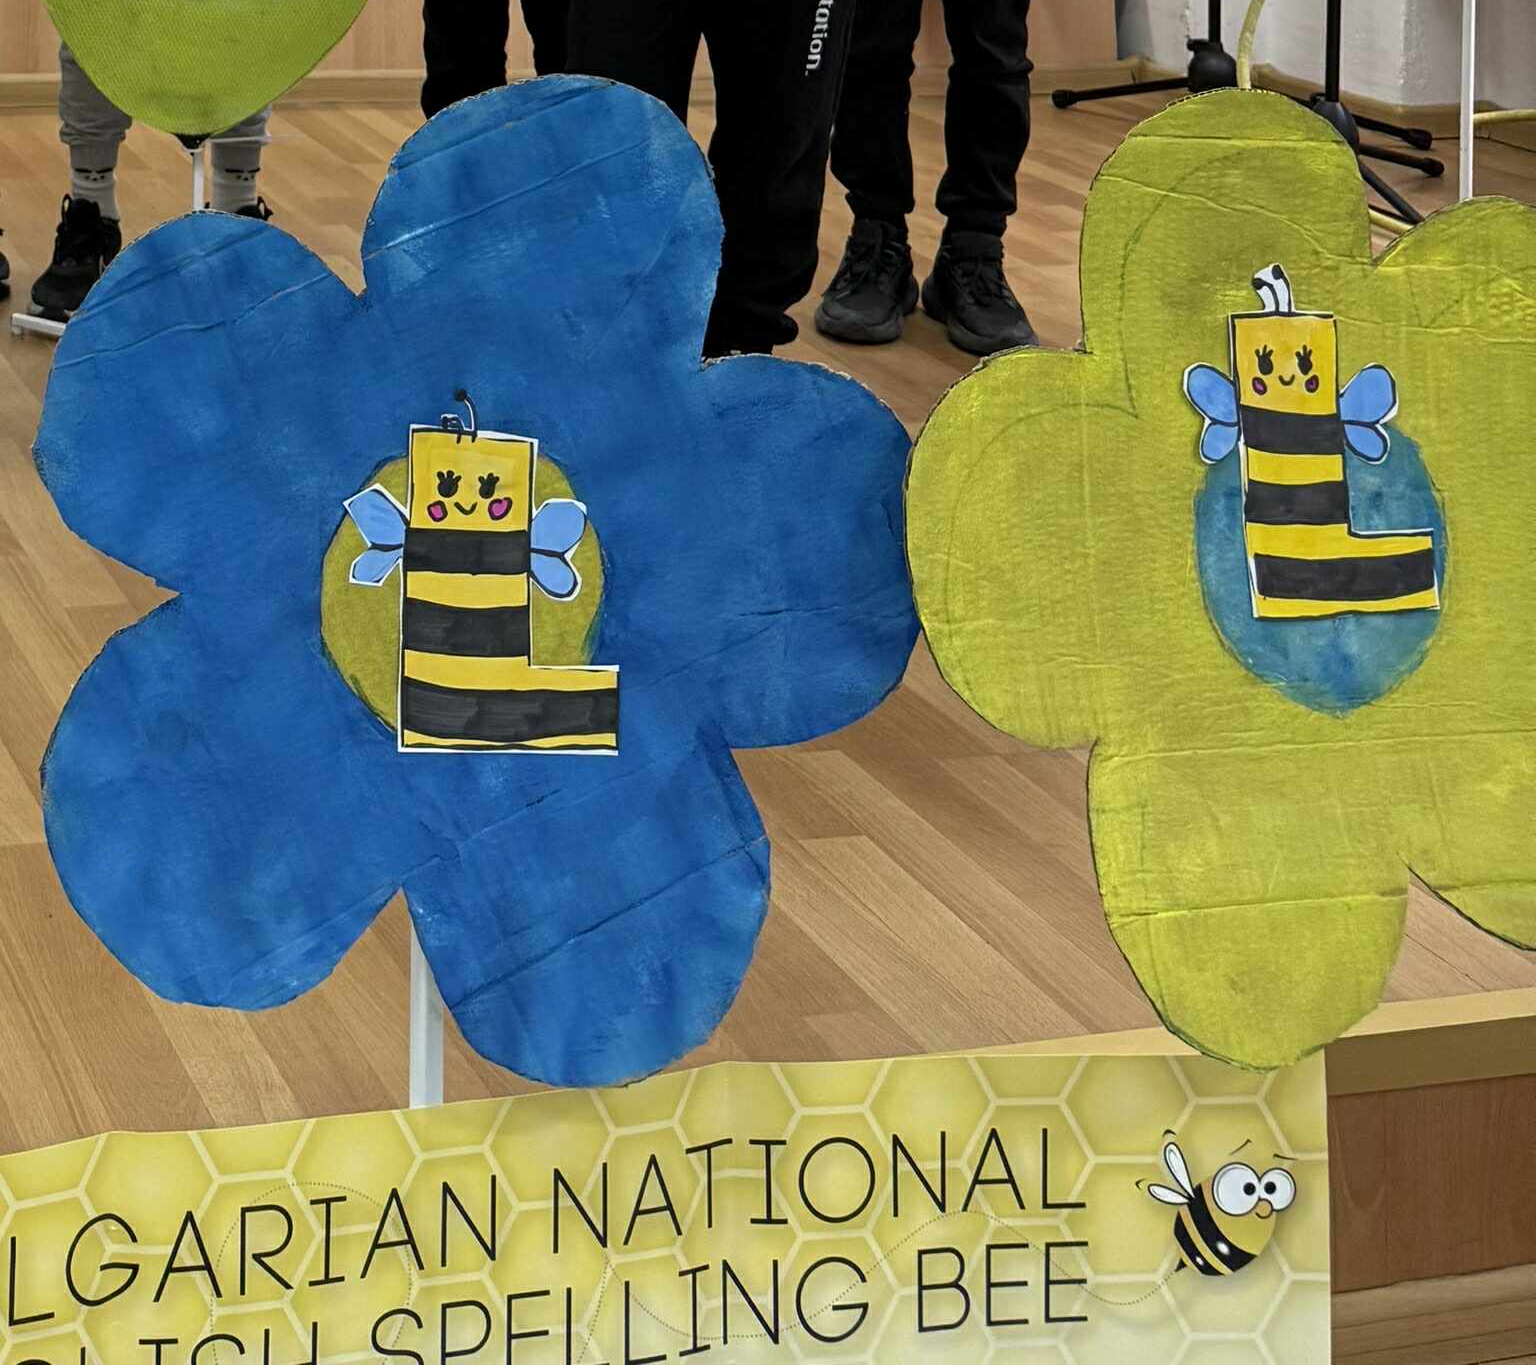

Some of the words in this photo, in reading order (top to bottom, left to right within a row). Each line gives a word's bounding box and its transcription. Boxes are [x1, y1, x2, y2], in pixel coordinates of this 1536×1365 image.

[552, 1128, 1087, 1253] NATIONAL
[370, 1256, 869, 1365] SPELLING
[917, 1242, 1089, 1333] BEE
